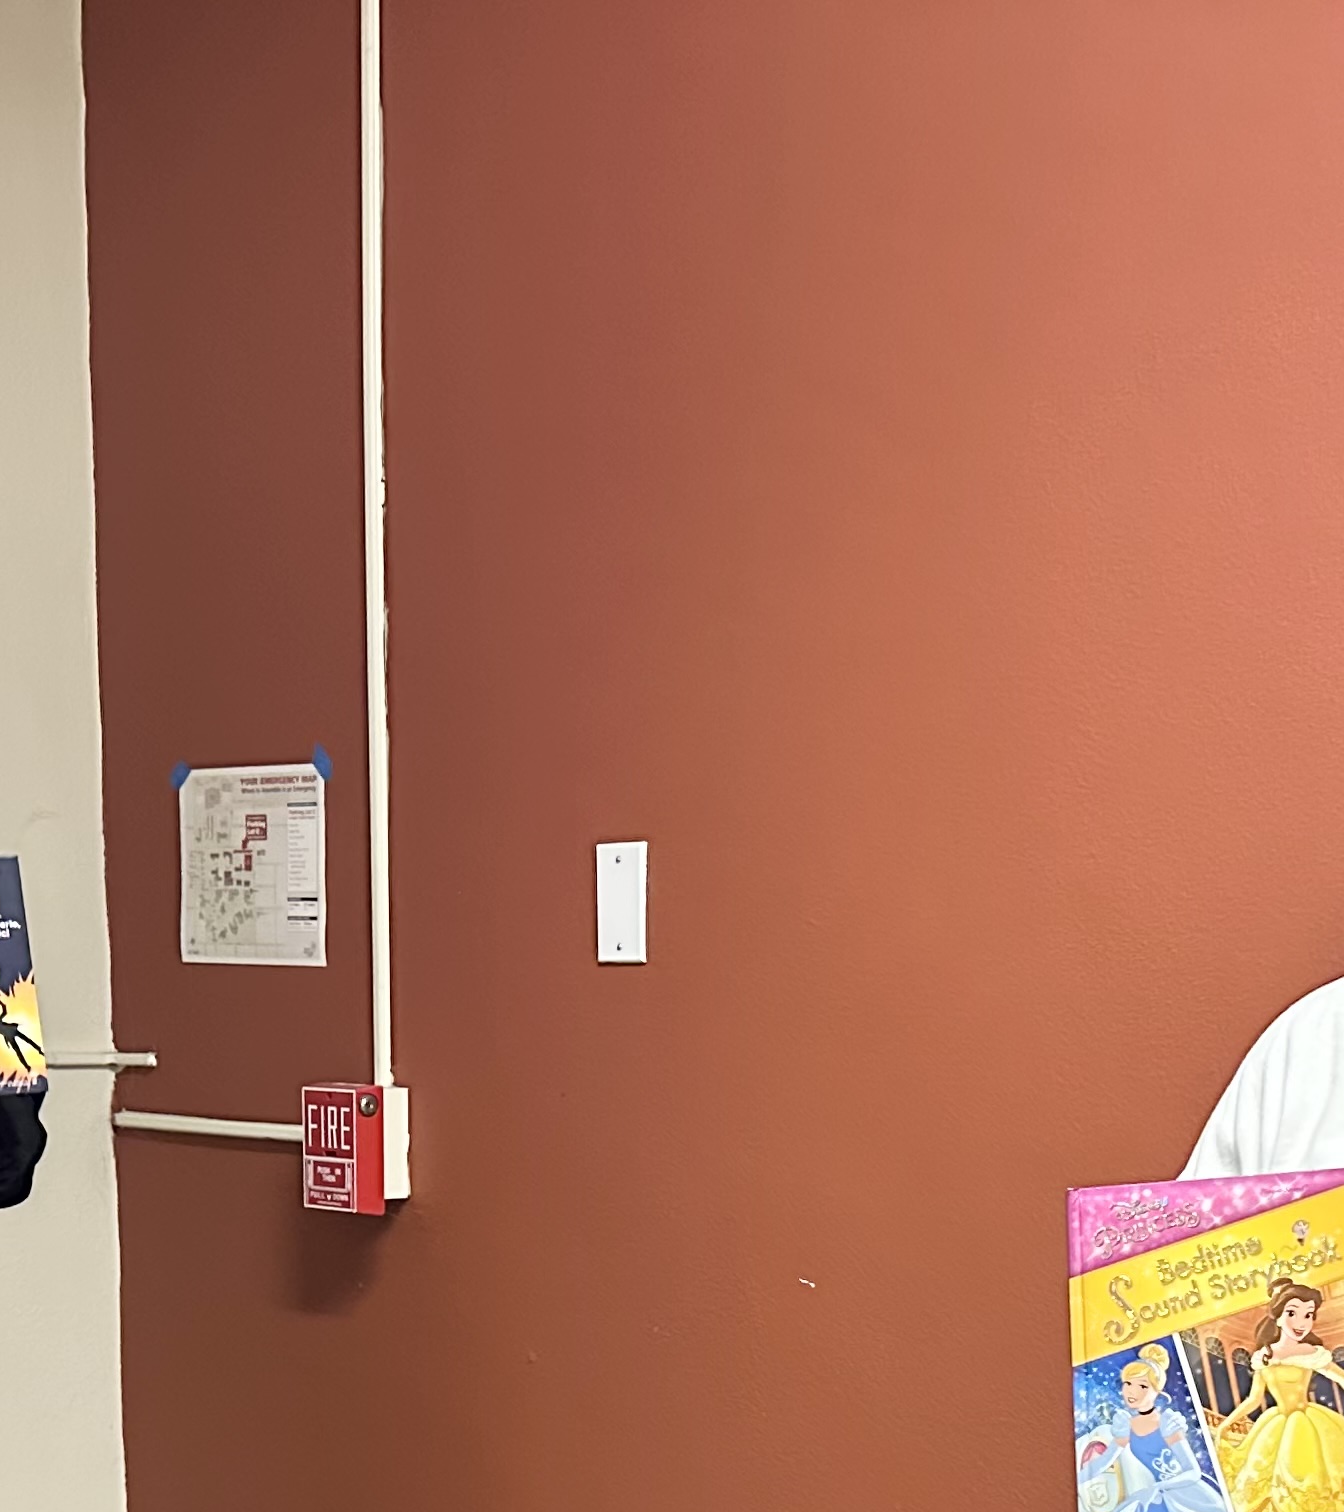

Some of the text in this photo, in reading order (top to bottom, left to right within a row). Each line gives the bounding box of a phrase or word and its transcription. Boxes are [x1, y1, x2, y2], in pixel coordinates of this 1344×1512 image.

[307, 1104, 351, 1150] FIRE
[1156, 1235, 1263, 1285] Bedtime
[1104, 1236, 1343, 1346] Sound Storybook
